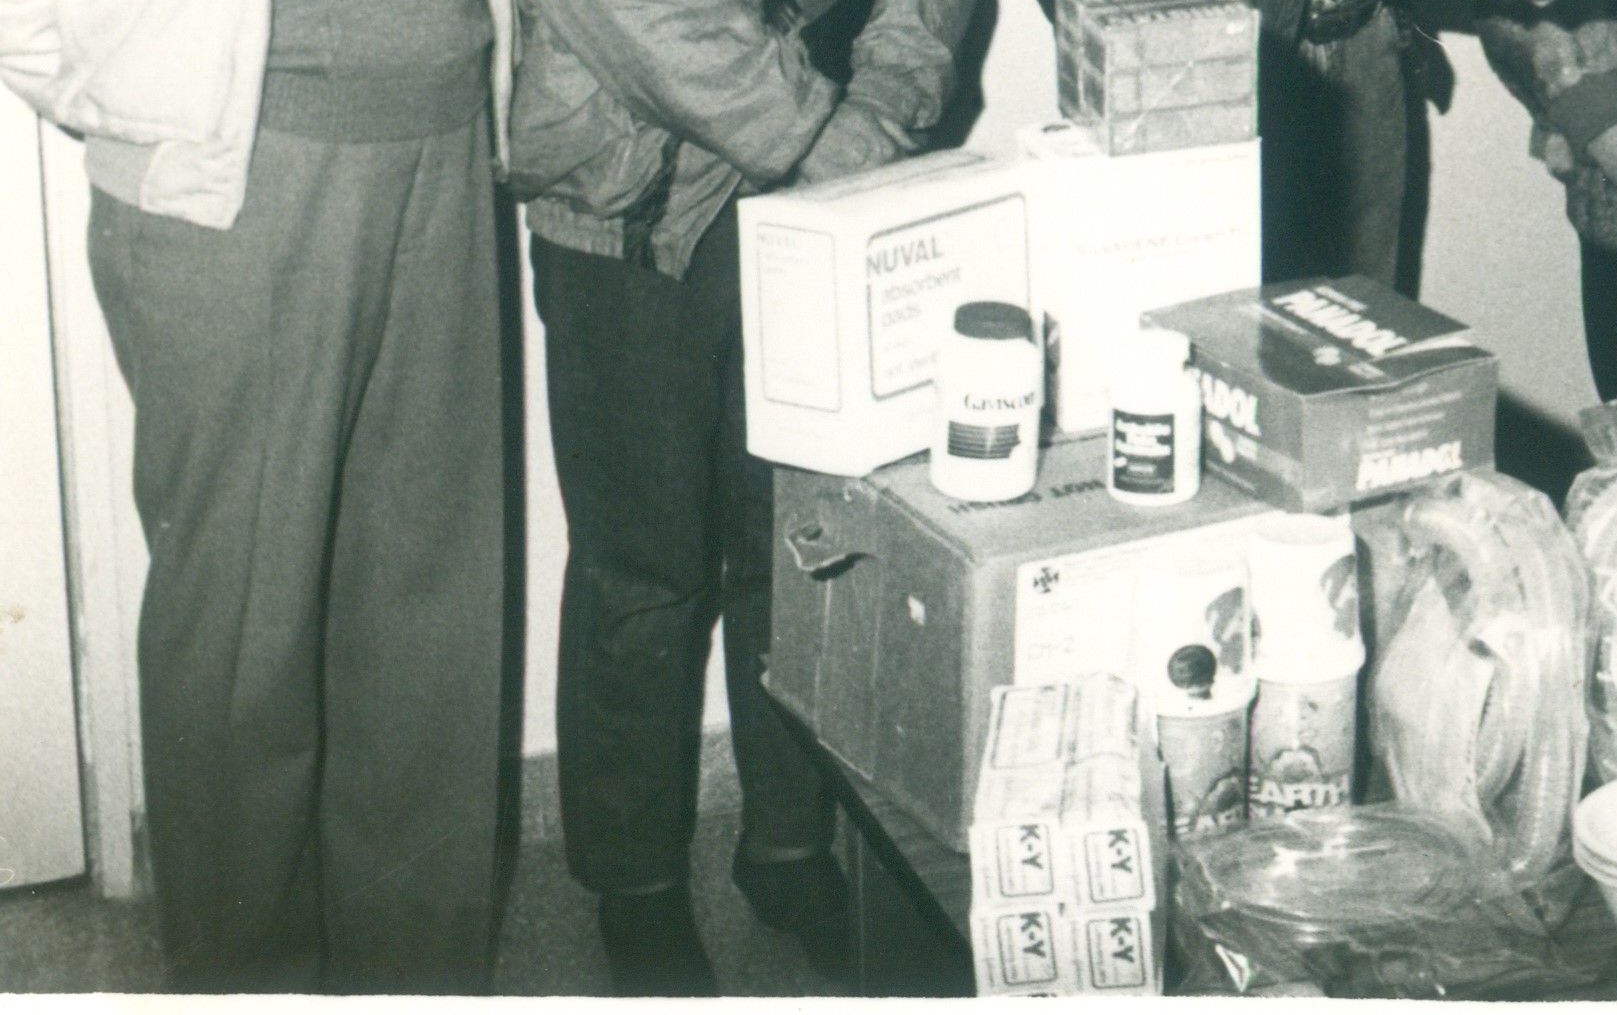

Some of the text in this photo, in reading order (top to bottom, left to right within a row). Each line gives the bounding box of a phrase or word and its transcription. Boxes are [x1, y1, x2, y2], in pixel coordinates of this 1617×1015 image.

[866, 236, 944, 276] NUVAL
[882, 266, 961, 303] absorbent
[1020, 824, 1043, 870] K-Y
[1108, 829, 1133, 874] K-Y
[1020, 912, 1047, 958] K-Y
[1110, 917, 1135, 964] K-Y
